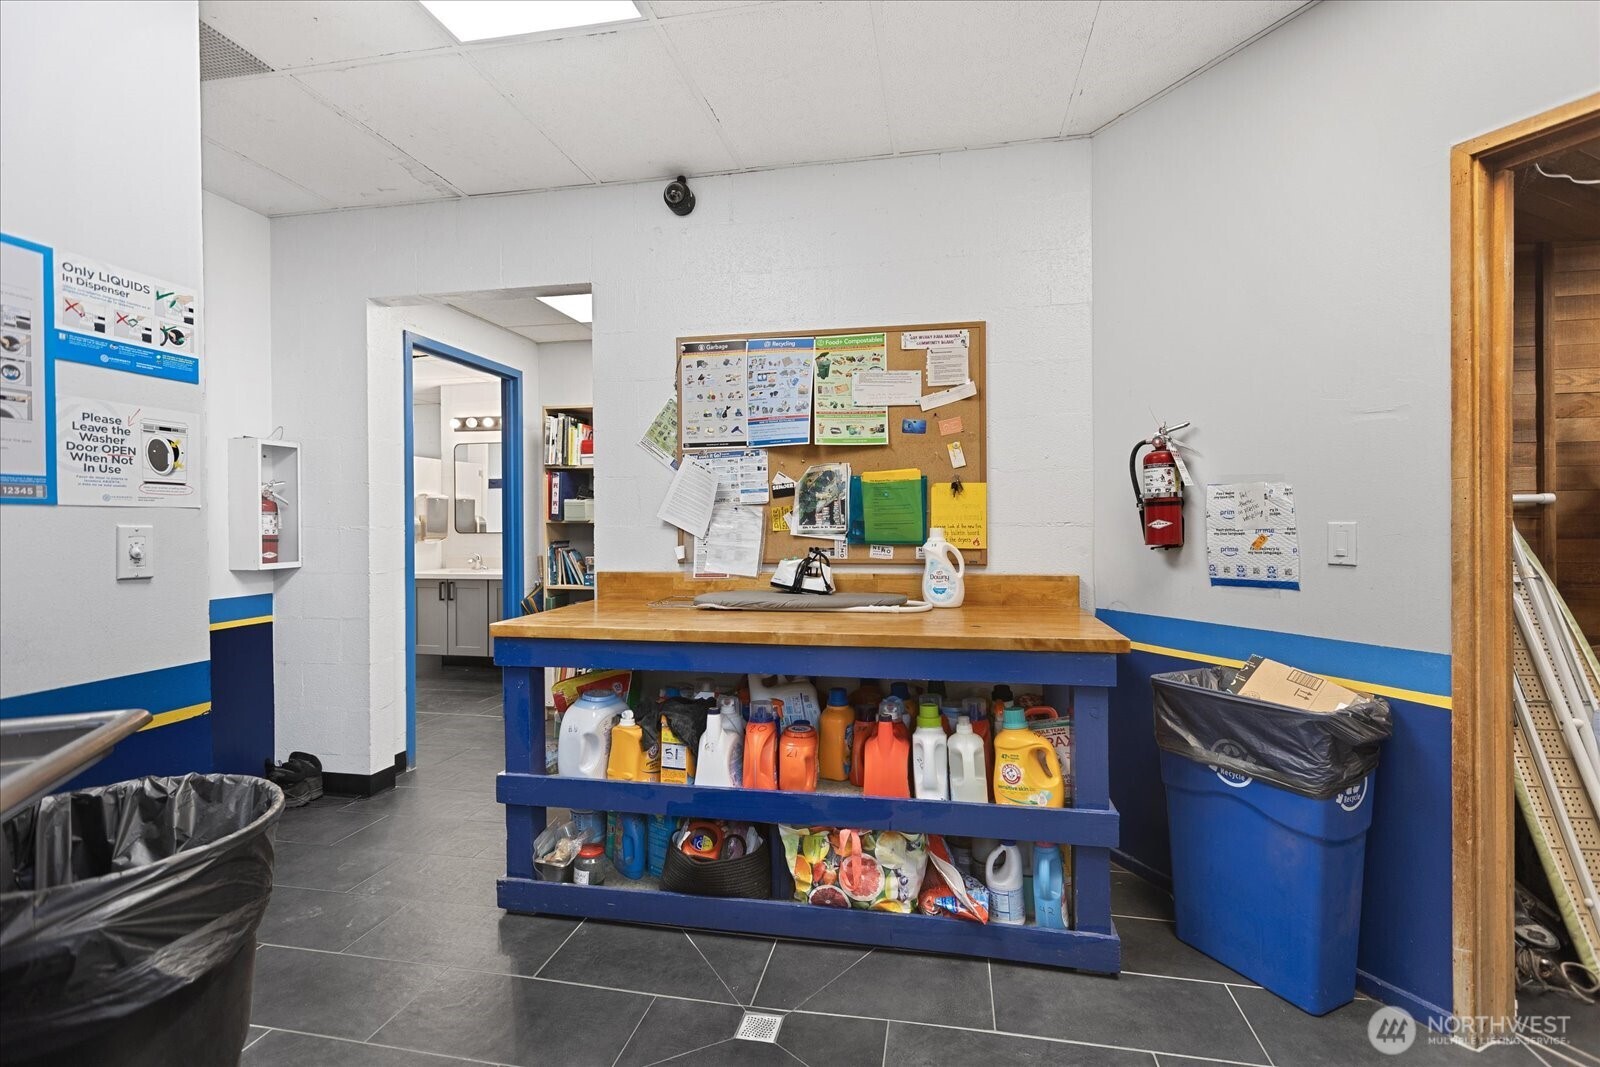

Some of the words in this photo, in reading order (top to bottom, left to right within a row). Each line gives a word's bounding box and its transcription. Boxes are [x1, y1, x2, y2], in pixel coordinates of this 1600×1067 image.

[62, 262, 94, 279] Only
[99, 272, 151, 295] LIQUIDS
[62, 273, 73, 283] In
[76, 277, 130, 299] Dispenser
[706, 343, 729, 351] Garbage
[772, 340, 796, 348] Recycling
[843, 336, 883, 345] Compostables
[82, 412, 122, 425] Please
[72, 421, 108, 434] Leave
[111, 425, 131, 436] the
[79, 432, 125, 445] Washer
[66, 441, 98, 452] Door
[101, 444, 137, 456] OPEN
[70, 452, 108, 463] When
[111, 455, 134, 465] Not
[83, 463, 95, 473] In
[99, 464, 122, 474] Use
[2, 486, 33, 495] 12345
[930, 573, 950, 582] Downy
[665, 747, 679, 760] 51
[1220, 767, 1245, 781] Recycle
